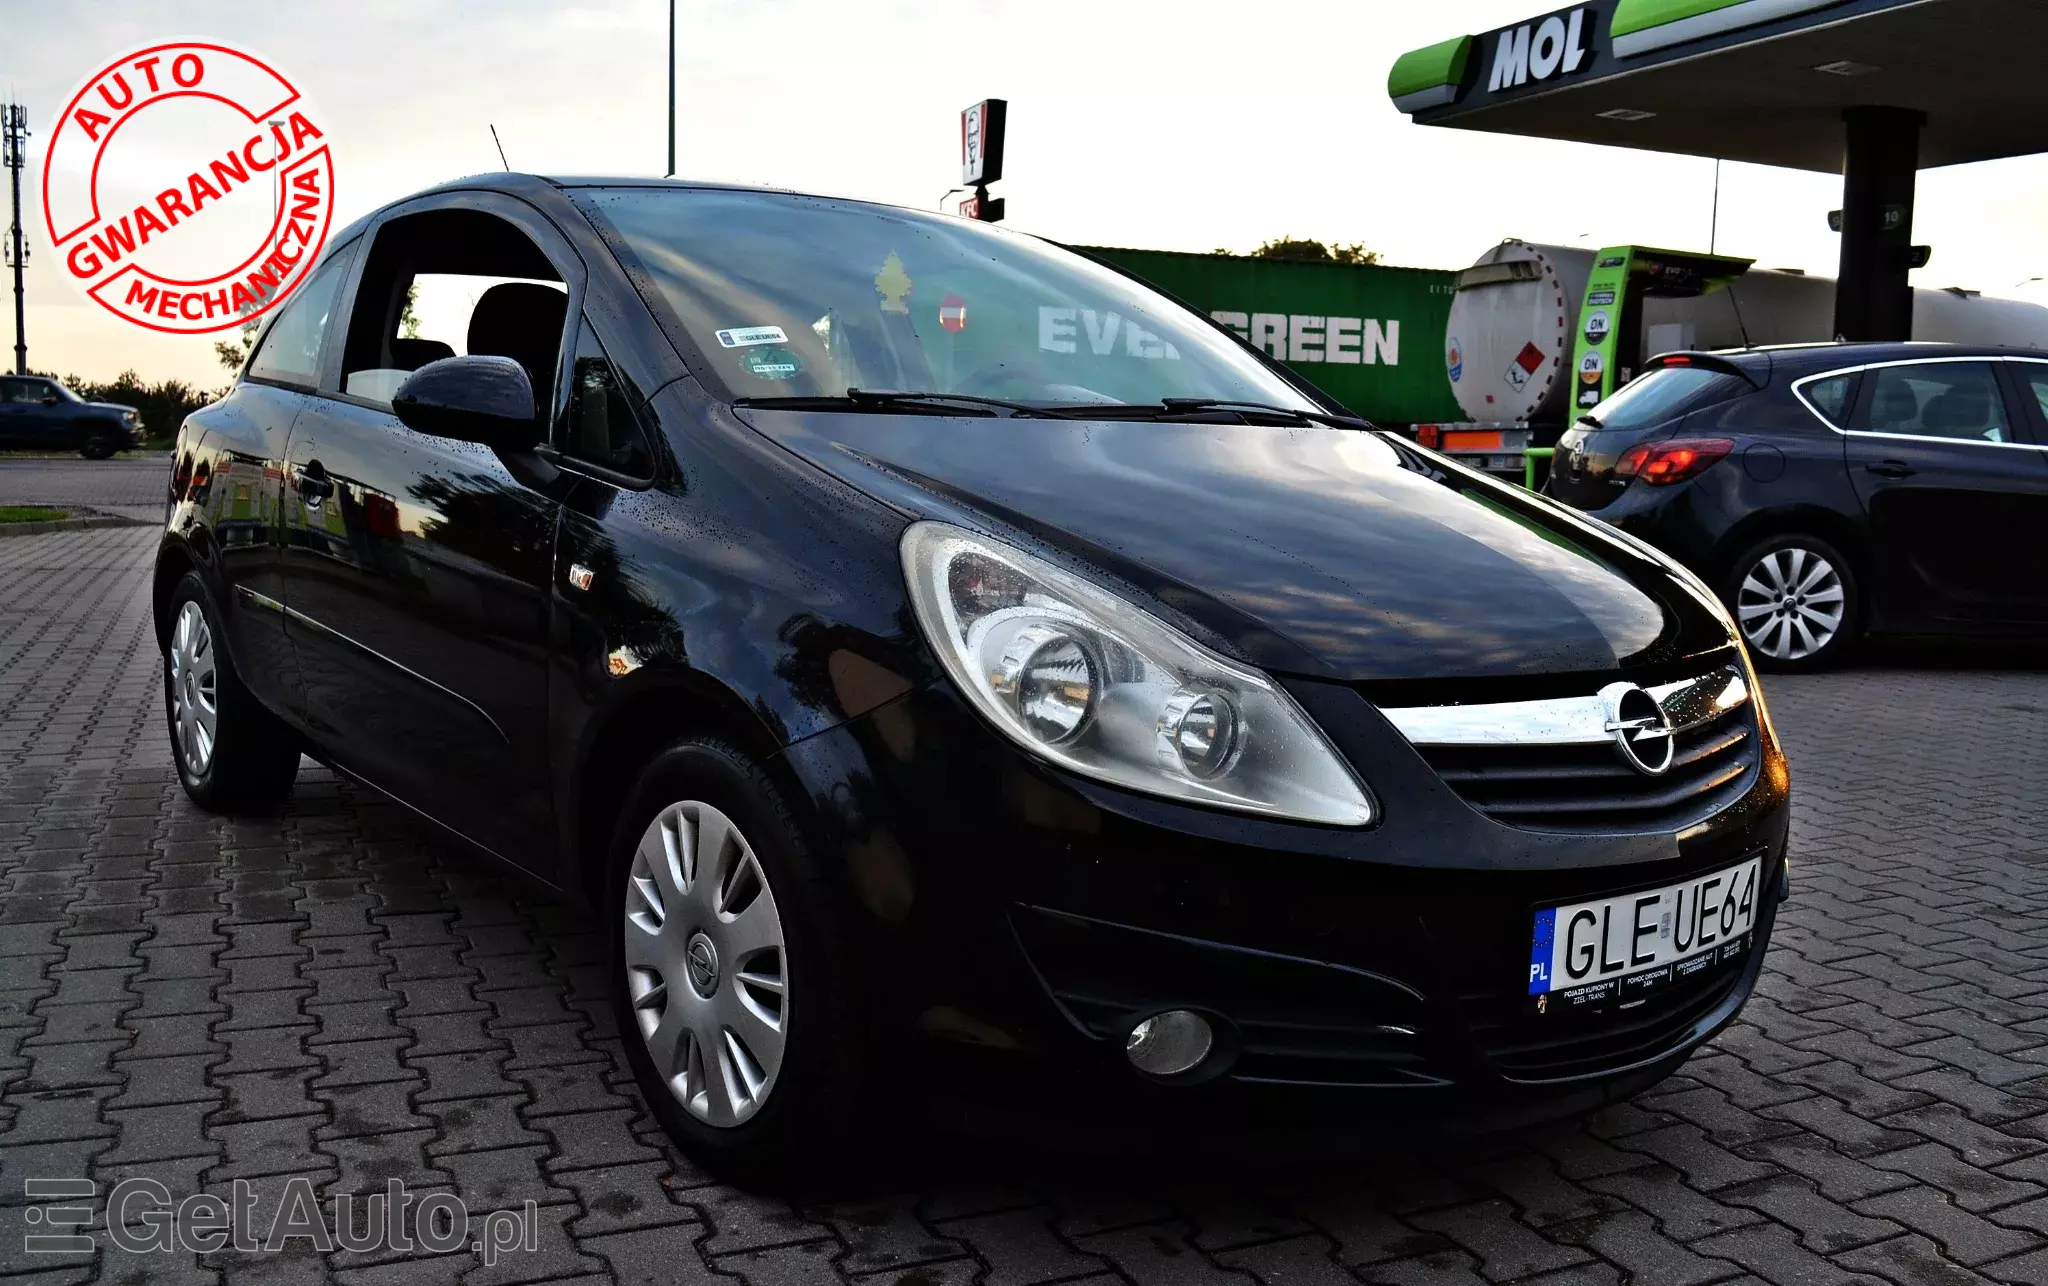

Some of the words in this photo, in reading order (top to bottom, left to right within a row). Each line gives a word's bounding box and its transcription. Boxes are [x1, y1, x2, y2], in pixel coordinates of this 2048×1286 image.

[1487, 8, 1586, 93] MOL
[961, 200, 978, 219] KFC
[1884, 211, 1899, 224] 10
[1590, 318, 1604, 330] ON
[1038, 305, 1400, 366] EVEGREEN
[1584, 359, 1598, 370] ON
[1565, 894, 1661, 980] GLE
[1673, 863, 1757, 953] UE64
[1529, 963, 1548, 983] PL
[1627, 974, 1644, 985] POMOC
[1564, 987, 1585, 998] POJAZD
[1585, 983, 1608, 994] KUPIONY
